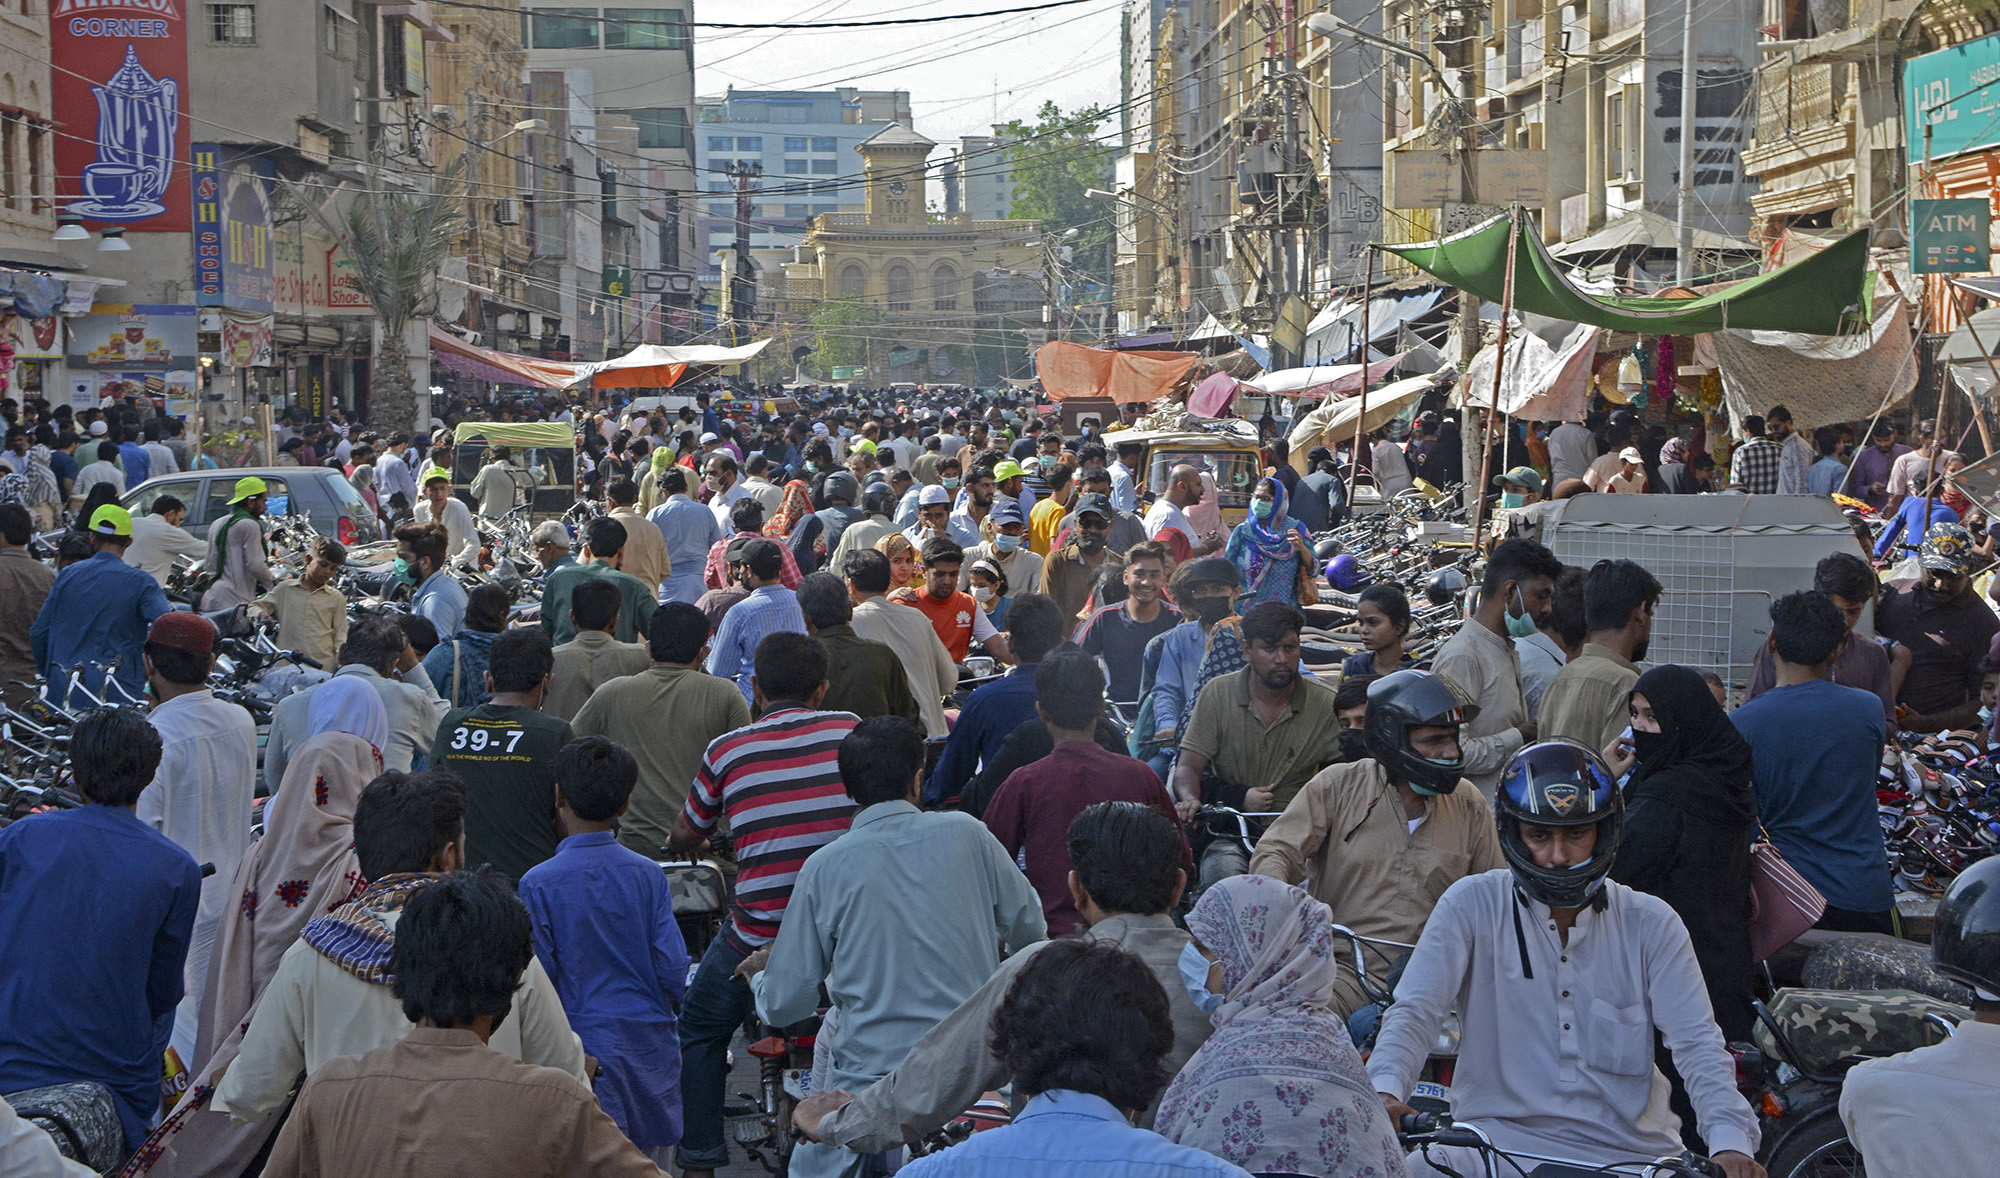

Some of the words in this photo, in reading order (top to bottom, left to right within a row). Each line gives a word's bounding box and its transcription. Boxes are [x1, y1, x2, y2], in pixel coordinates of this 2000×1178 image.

[69, 17, 169, 38] CORNER
[1914, 77, 1959, 129] HBL
[195, 152, 215, 172] H
[198, 177, 217, 199] &
[199, 203, 218, 223] H
[1928, 214, 1976, 232] ATM
[229, 219, 243, 265] H
[252, 225, 266, 270] H
[201, 232, 219, 295] SHOES
[332, 290, 360, 304] Shoe
[312, 375, 321, 418] LAHORE
[450, 727, 524, 753] 39-7
[161, 1071, 187, 1096] NG
[1417, 1083, 1445, 1098] 5761
